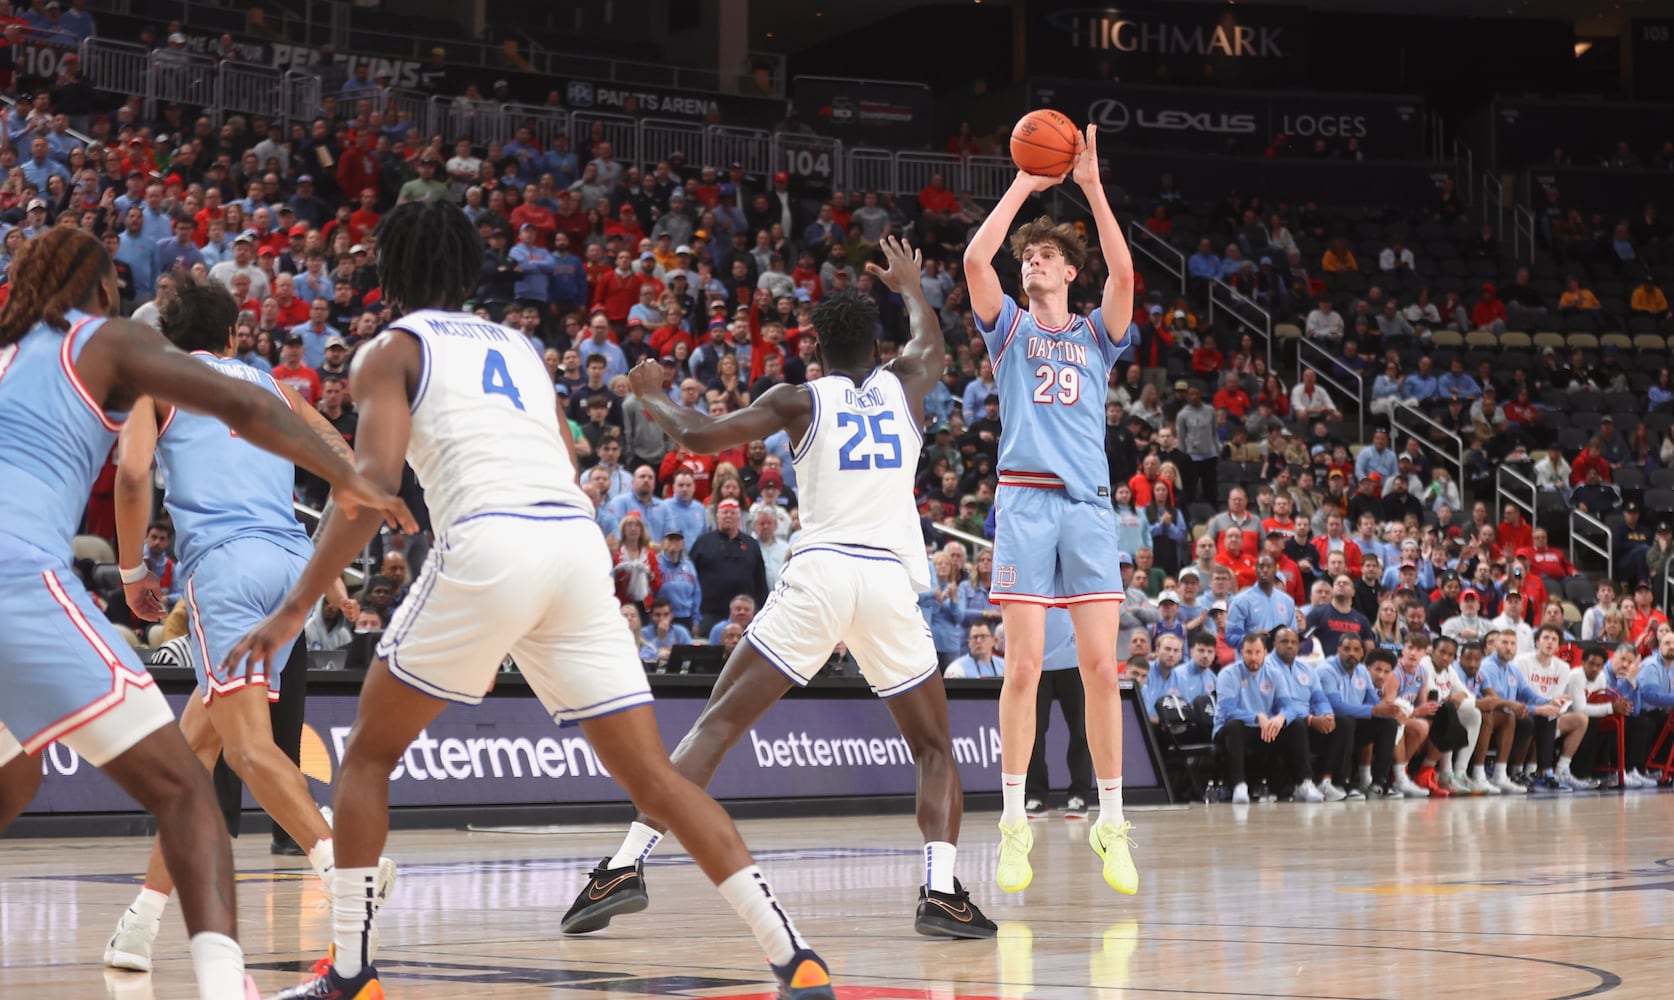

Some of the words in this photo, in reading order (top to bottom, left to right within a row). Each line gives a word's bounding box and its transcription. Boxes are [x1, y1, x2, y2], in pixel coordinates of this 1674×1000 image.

[1072, 17, 1283, 56] HIGHMARK
[271, 43, 422, 88] PEUINS
[1136, 109, 1256, 133] LEXUS
[1283, 115, 1367, 138] LOGES
[786, 149, 831, 177] 104
[1027, 336, 1088, 368] DAYTON
[482, 348, 527, 413] 4
[1033, 364, 1080, 406] 29
[836, 411, 902, 470] 25
[329, 726, 615, 781] ttermen
